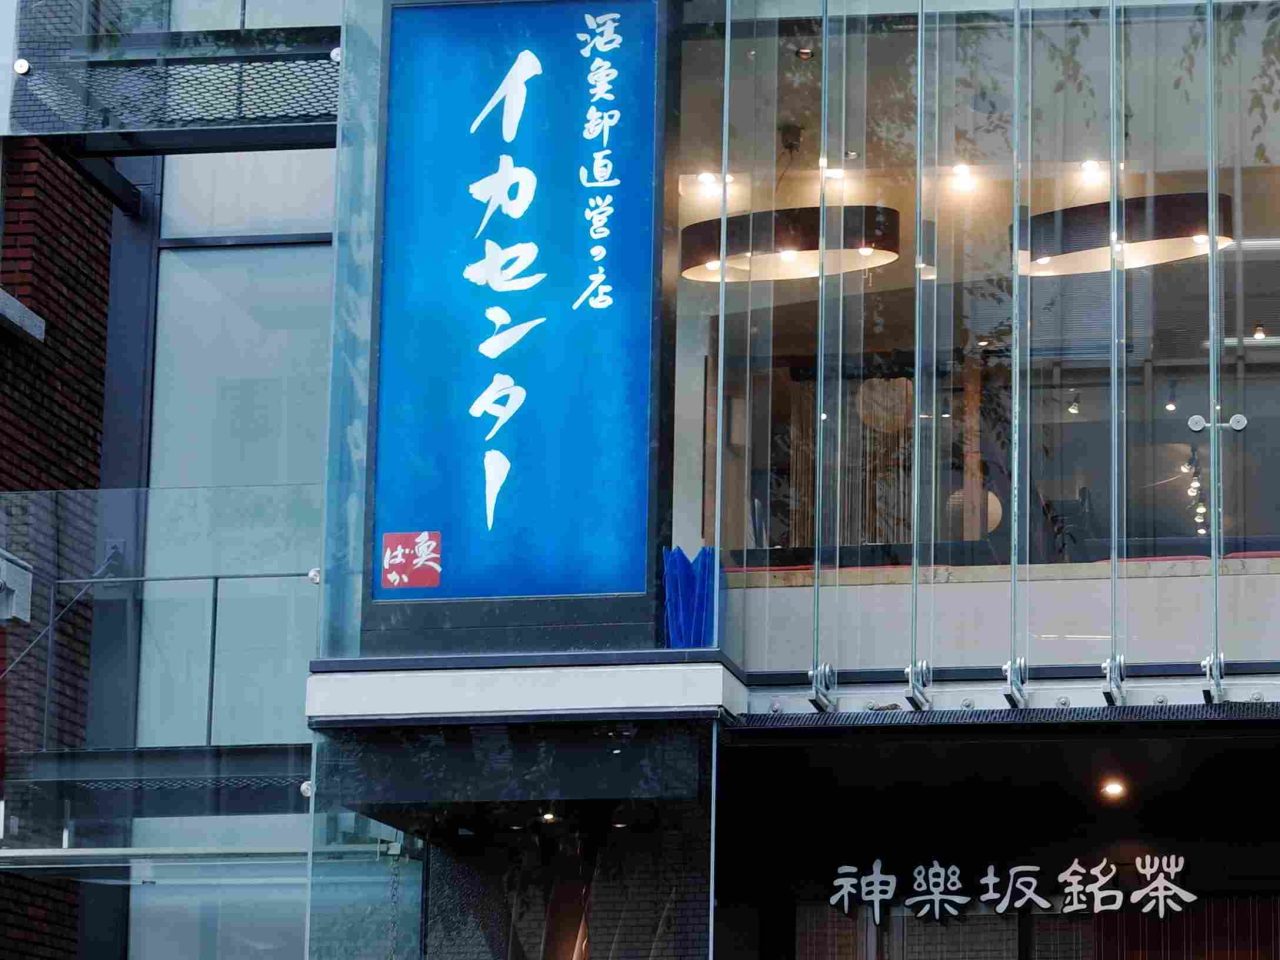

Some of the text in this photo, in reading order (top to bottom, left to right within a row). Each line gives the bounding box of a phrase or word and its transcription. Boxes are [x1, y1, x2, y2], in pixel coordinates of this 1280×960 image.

[462, 48, 548, 532] イカセンター
